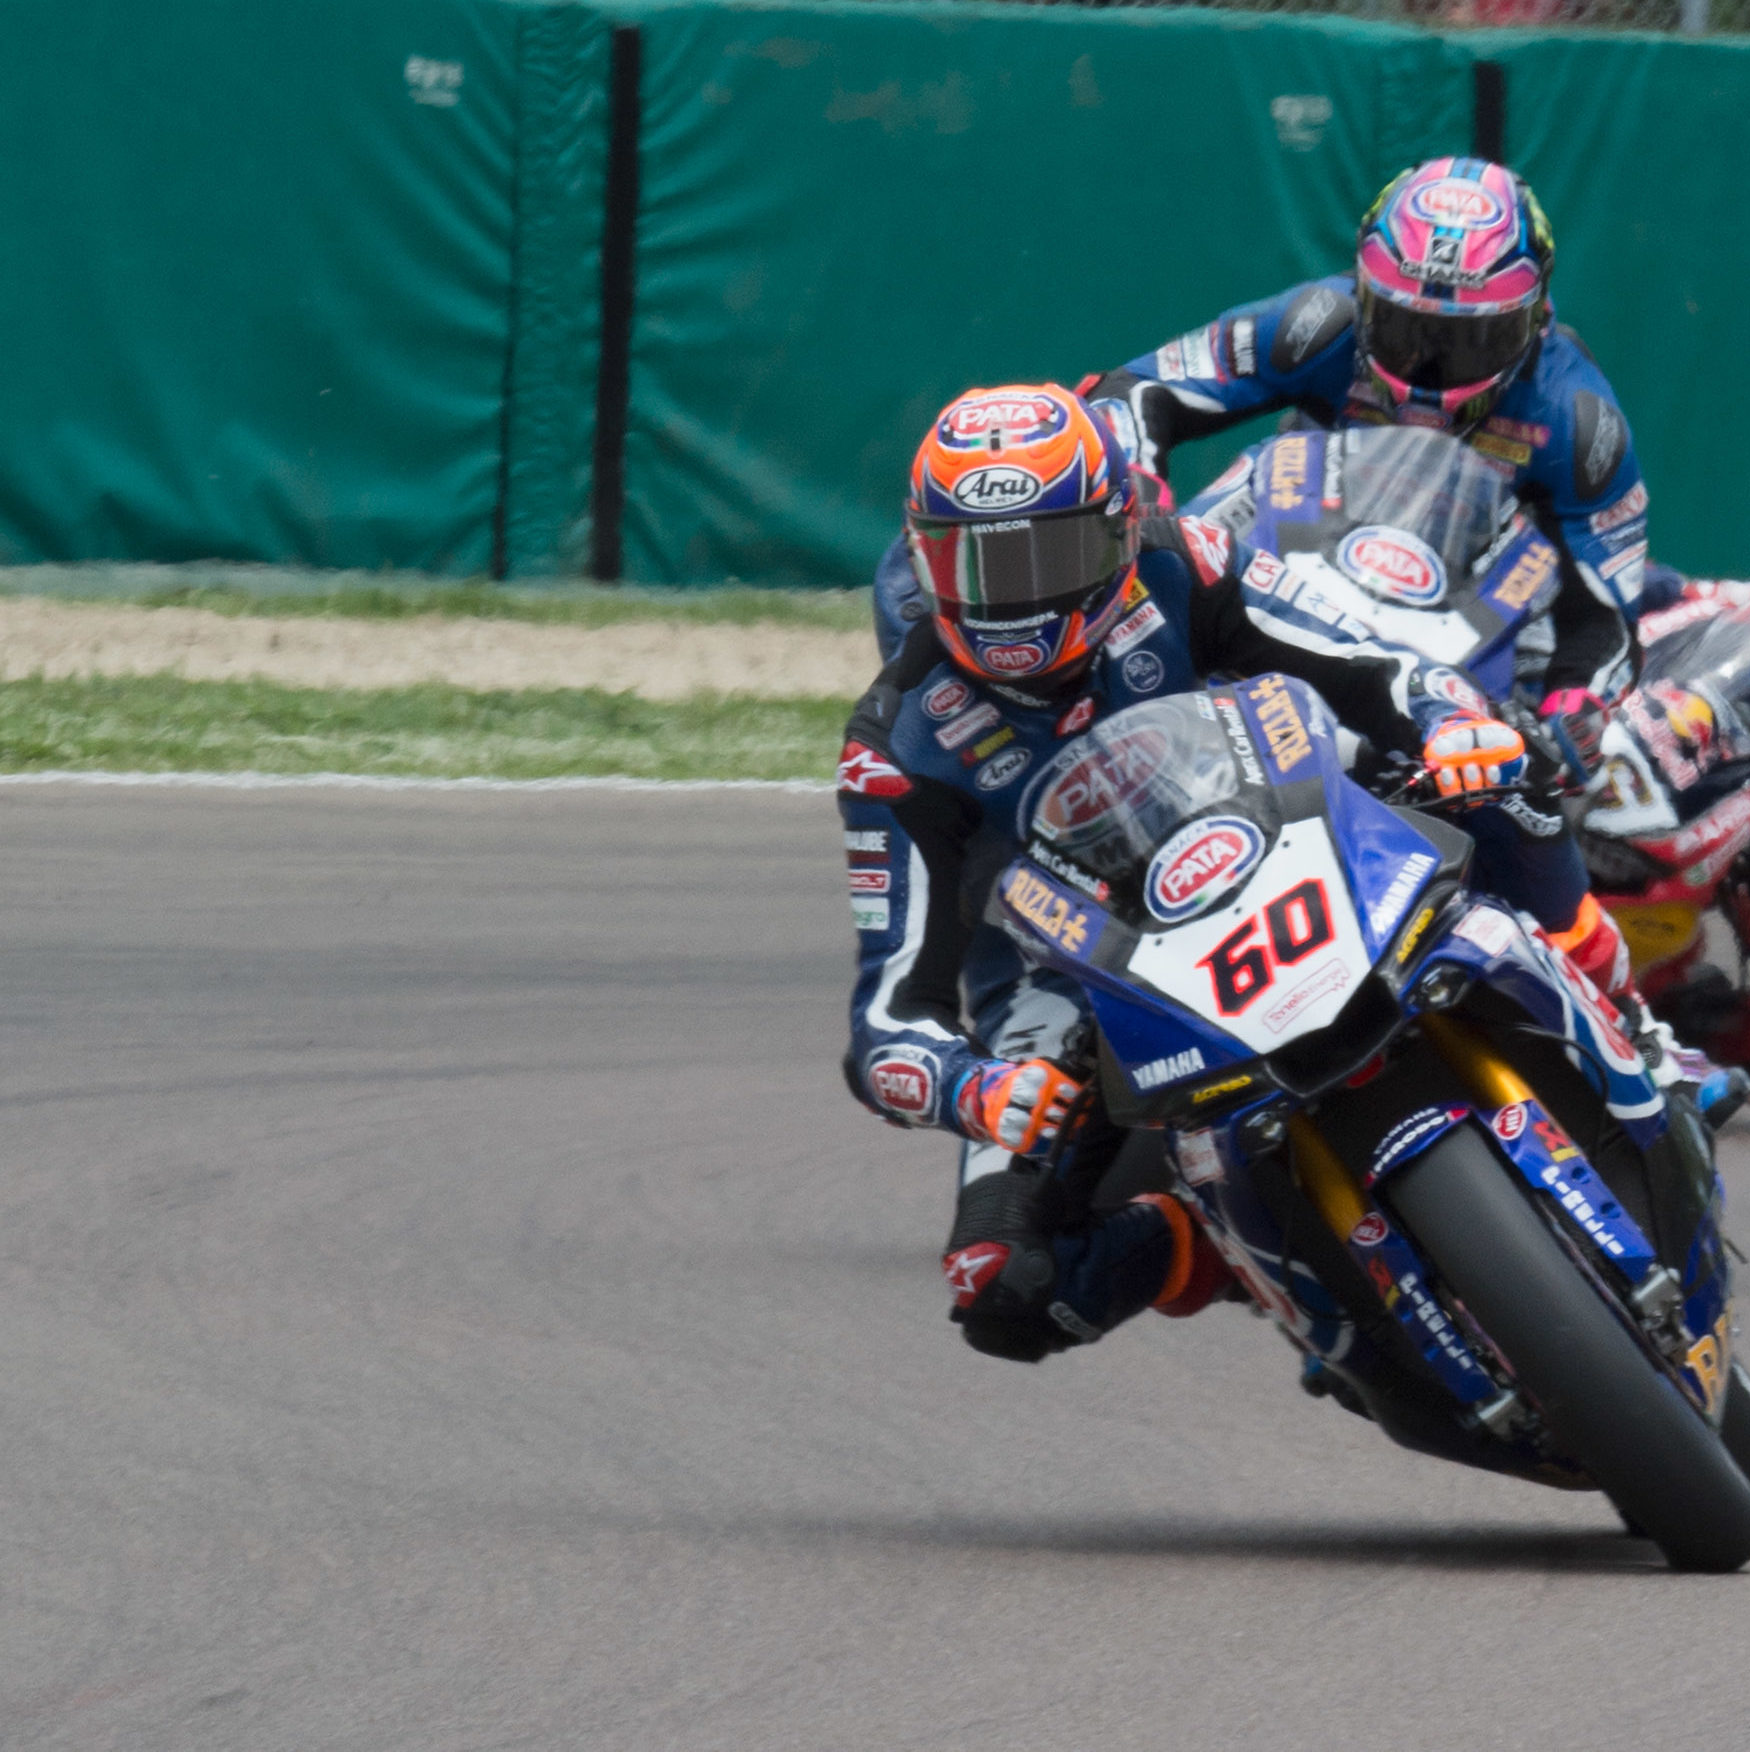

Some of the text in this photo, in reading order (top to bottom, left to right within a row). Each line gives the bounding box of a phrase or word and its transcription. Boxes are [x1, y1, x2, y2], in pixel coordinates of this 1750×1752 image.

[958, 404, 1038, 429] PATA
[961, 472, 1029, 500] Arai
[1361, 543, 1423, 585] PATA
[991, 650, 1034, 667] PATA
[1058, 744, 1155, 822] PATA
[1164, 838, 1239, 899] PATA
[1376, 852, 1435, 924] YAMAHA
[1194, 878, 1336, 1017] 60
[876, 1070, 923, 1101] PATA
[1132, 1047, 1205, 1089] YAMAHA
[1541, 1164, 1625, 1256] PIRELLI
[1400, 1272, 1474, 1370] PIRELLI
